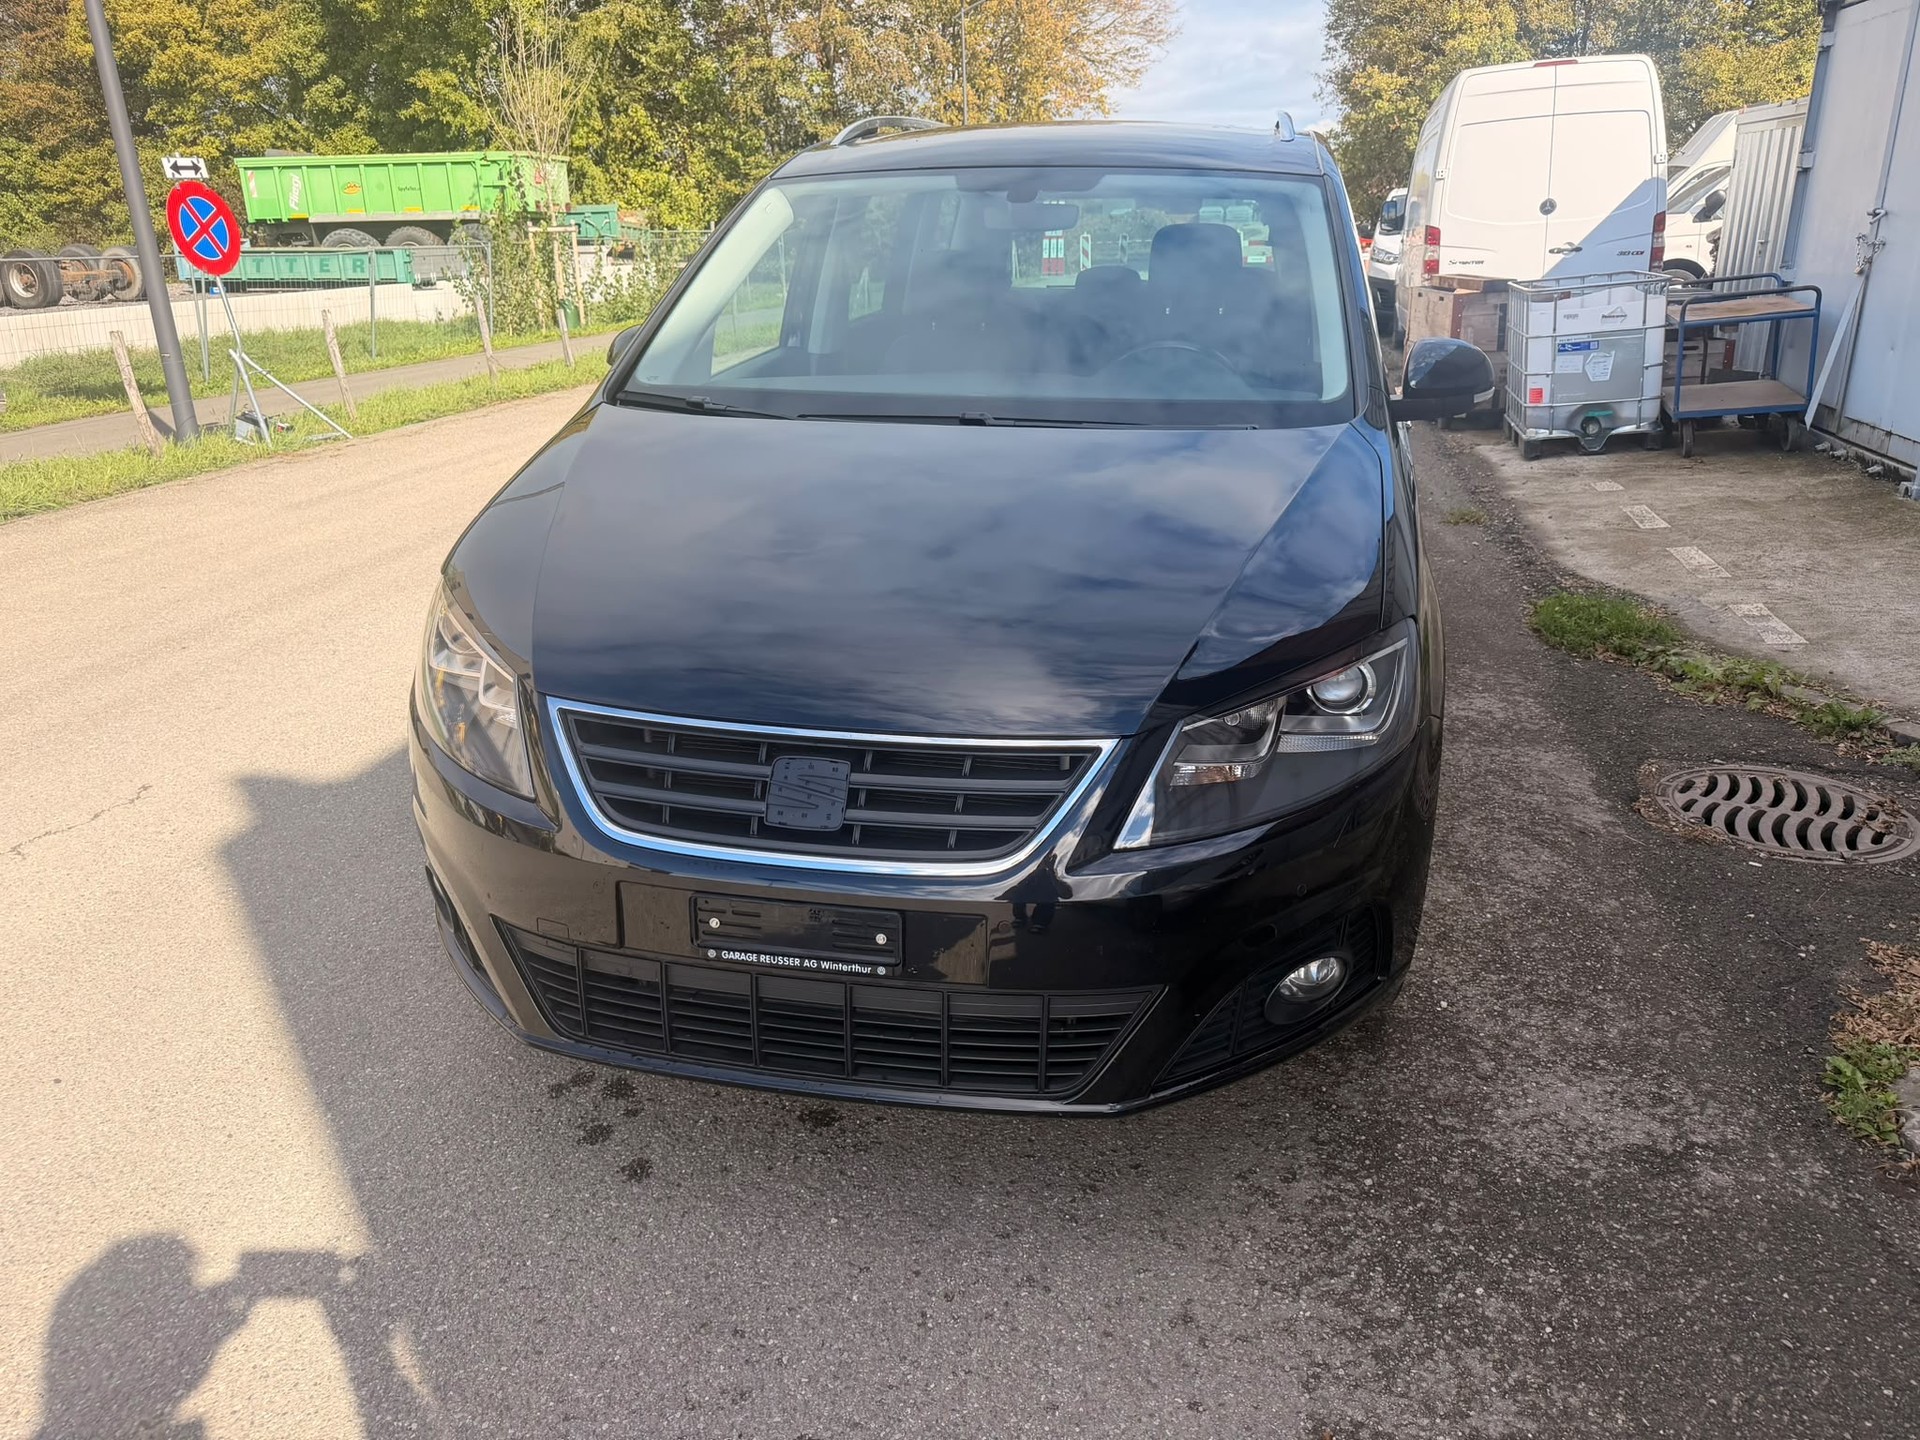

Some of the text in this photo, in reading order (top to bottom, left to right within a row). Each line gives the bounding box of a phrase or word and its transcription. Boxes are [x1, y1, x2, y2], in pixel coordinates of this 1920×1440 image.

[252, 258, 365, 274] TTER
[721, 950, 872, 974] GARAGE REUSSER AG Winterthur
